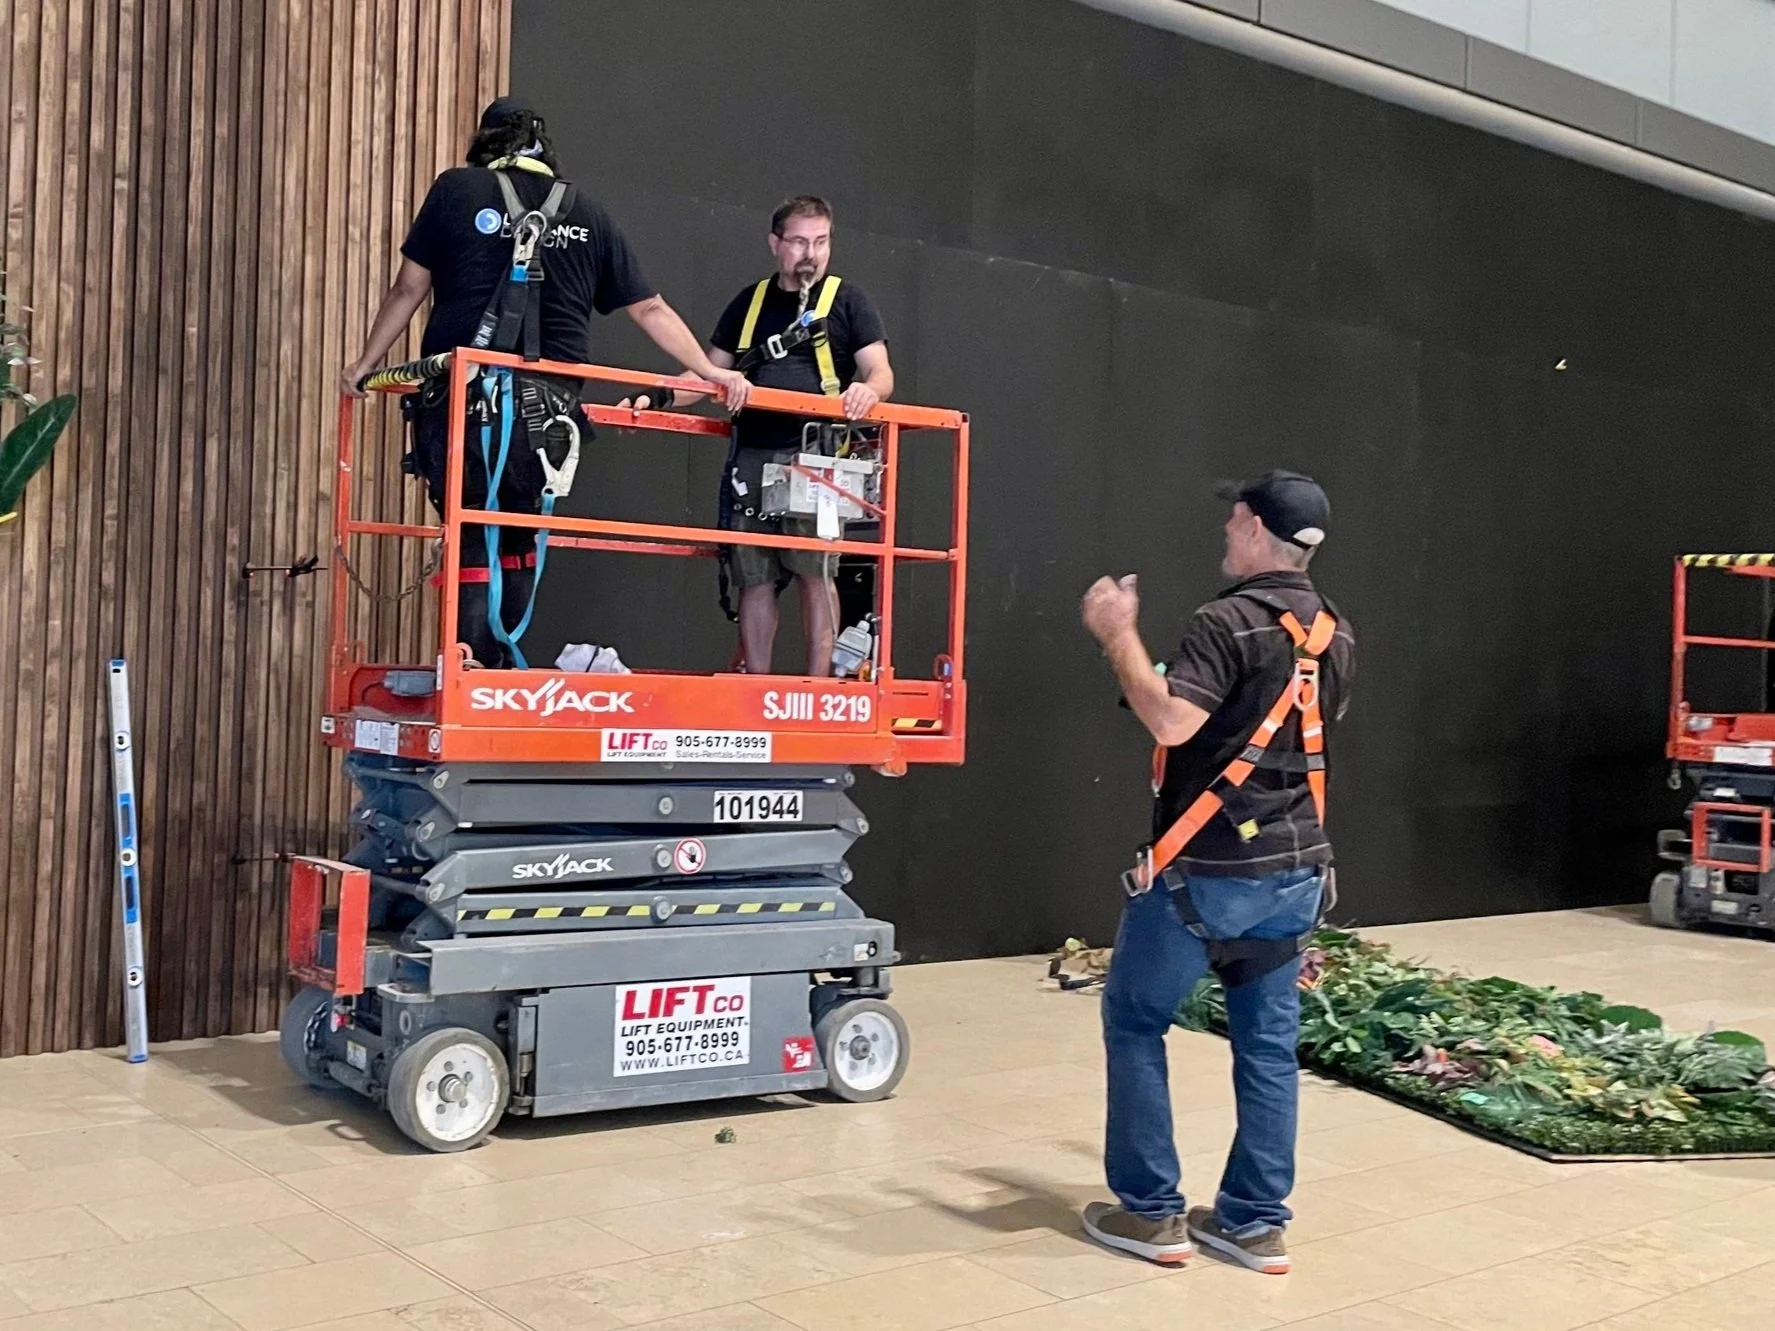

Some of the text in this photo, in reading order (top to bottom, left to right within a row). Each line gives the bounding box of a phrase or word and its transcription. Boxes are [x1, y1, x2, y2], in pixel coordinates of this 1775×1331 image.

[471, 678, 634, 716] SKYJACK
[763, 690, 871, 723] SJIII 3219
[675, 735, 767, 749] 905-677-8999
[714, 795, 800, 820] 101944
[511, 852, 615, 879] SKYJACK
[620, 1016, 745, 1037] LIFT EQUIPMENT
[620, 1049, 744, 1071] WWW.LIFTCO.CA
